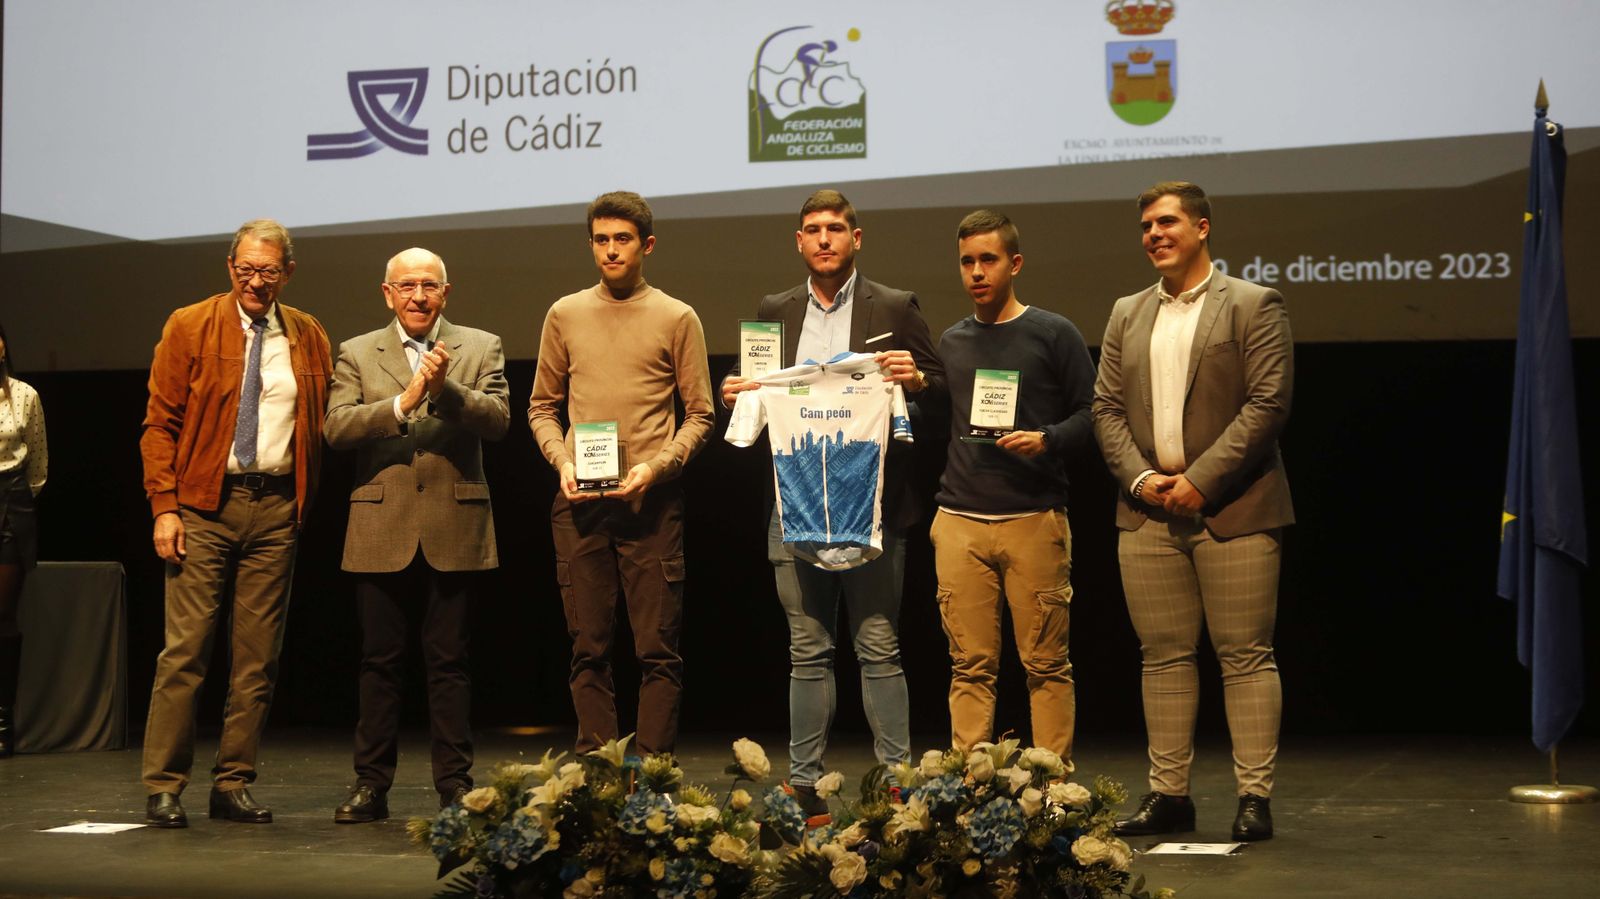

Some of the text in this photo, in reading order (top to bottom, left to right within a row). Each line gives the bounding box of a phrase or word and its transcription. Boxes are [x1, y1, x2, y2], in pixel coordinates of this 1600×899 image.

[447, 58, 637, 106] Diputación
[447, 113, 603, 154] de Cádiz
[783, 117, 863, 131] FEDERACIÓN
[766, 131, 834, 145] ANDALUZA
[786, 142, 865, 156] DE CICLISMO
[1242, 256, 1279, 283] de
[1285, 253, 1432, 282] diciembre
[1439, 252, 1511, 279] 2023
